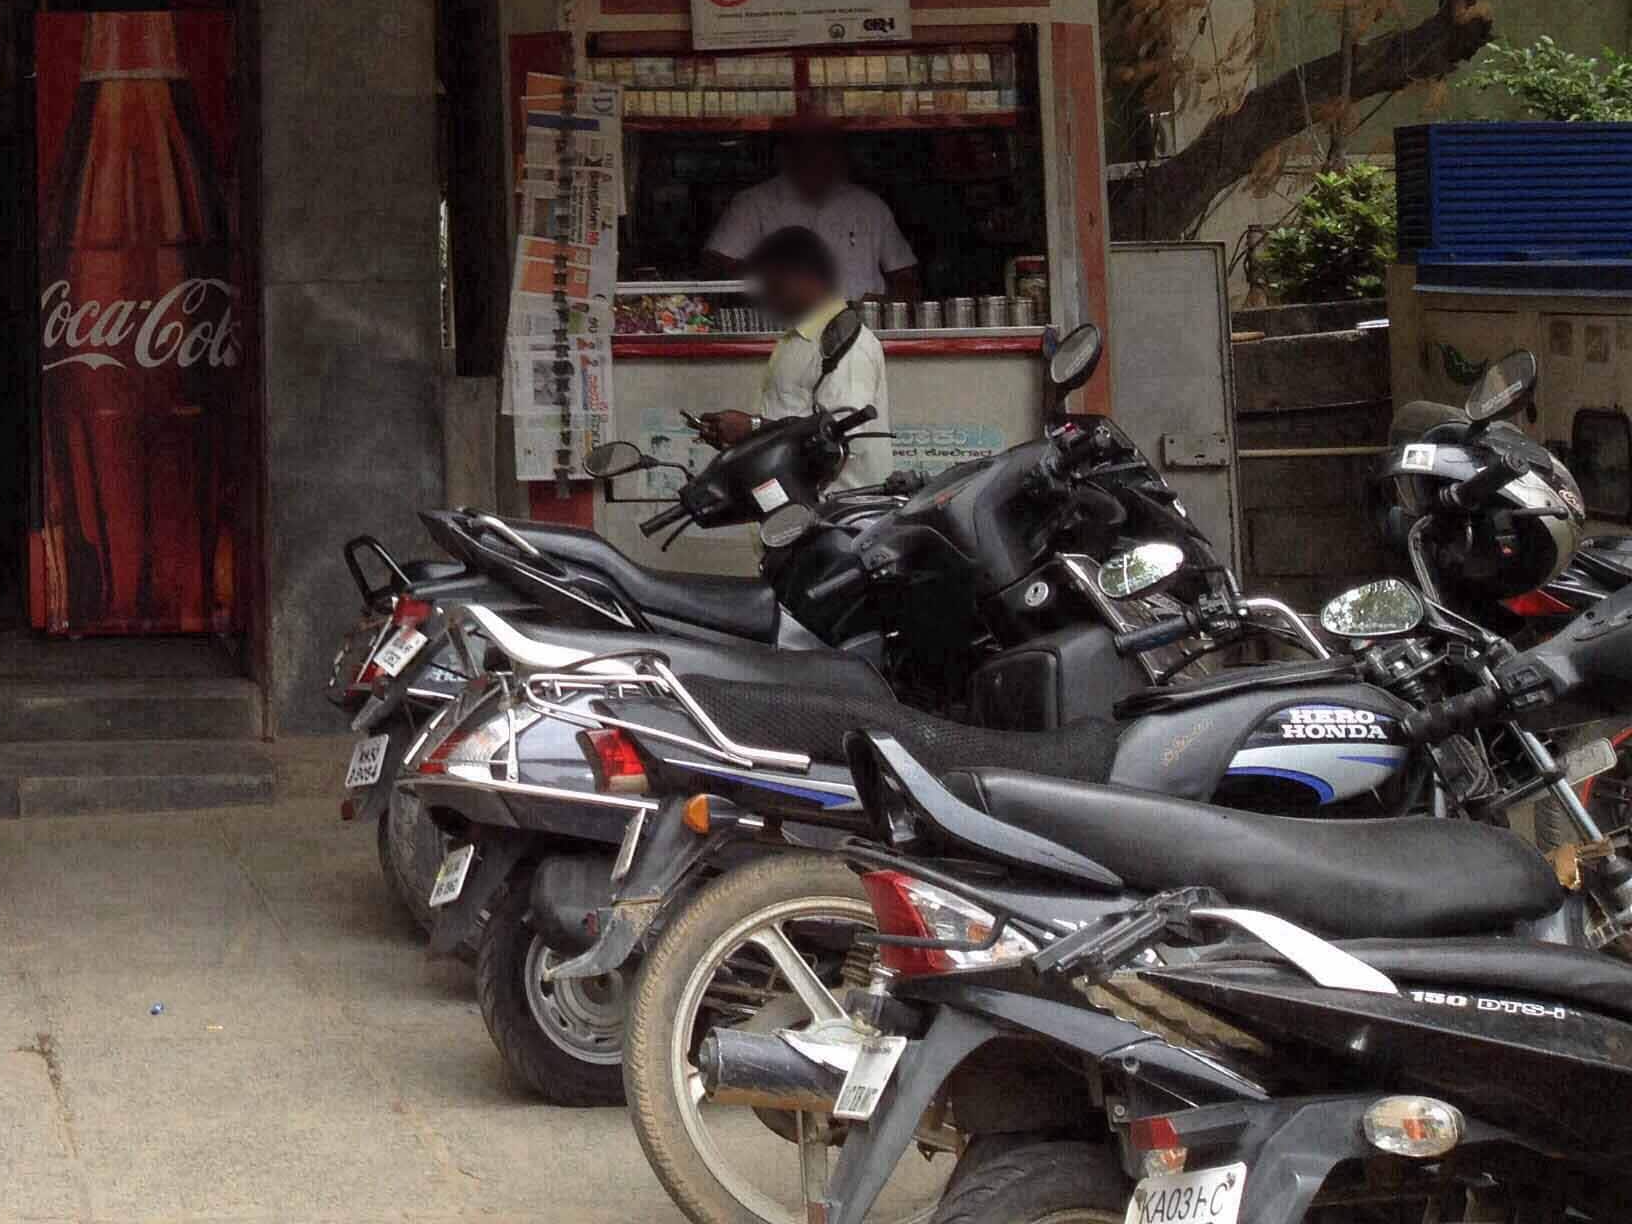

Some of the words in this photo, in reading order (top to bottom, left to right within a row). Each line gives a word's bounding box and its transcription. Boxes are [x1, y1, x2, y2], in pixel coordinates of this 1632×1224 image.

[1289, 709, 1375, 724] HERO
[1281, 724, 1387, 739] HONDA
[1409, 991, 1467, 1007] 150
